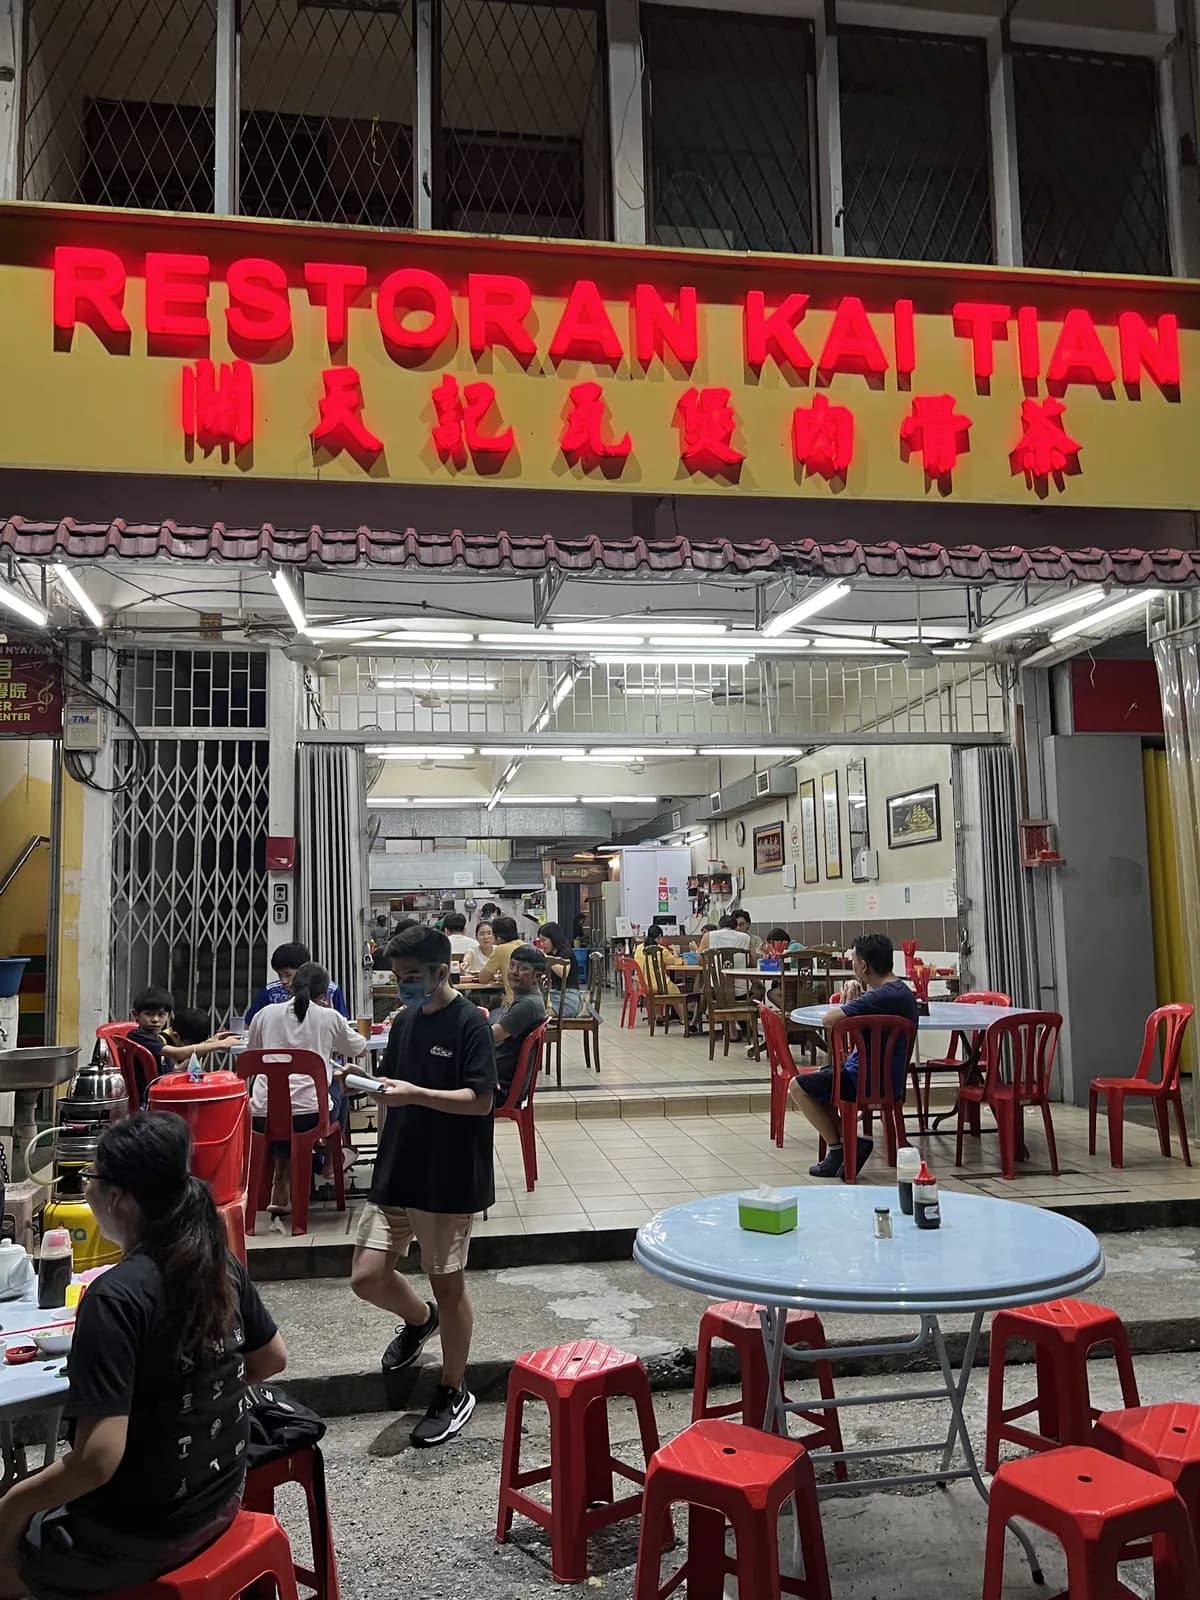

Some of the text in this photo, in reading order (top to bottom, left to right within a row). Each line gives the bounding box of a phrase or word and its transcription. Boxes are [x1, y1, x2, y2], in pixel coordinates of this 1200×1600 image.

[53, 246, 1181, 383] RESTORAN KAI TIAN
